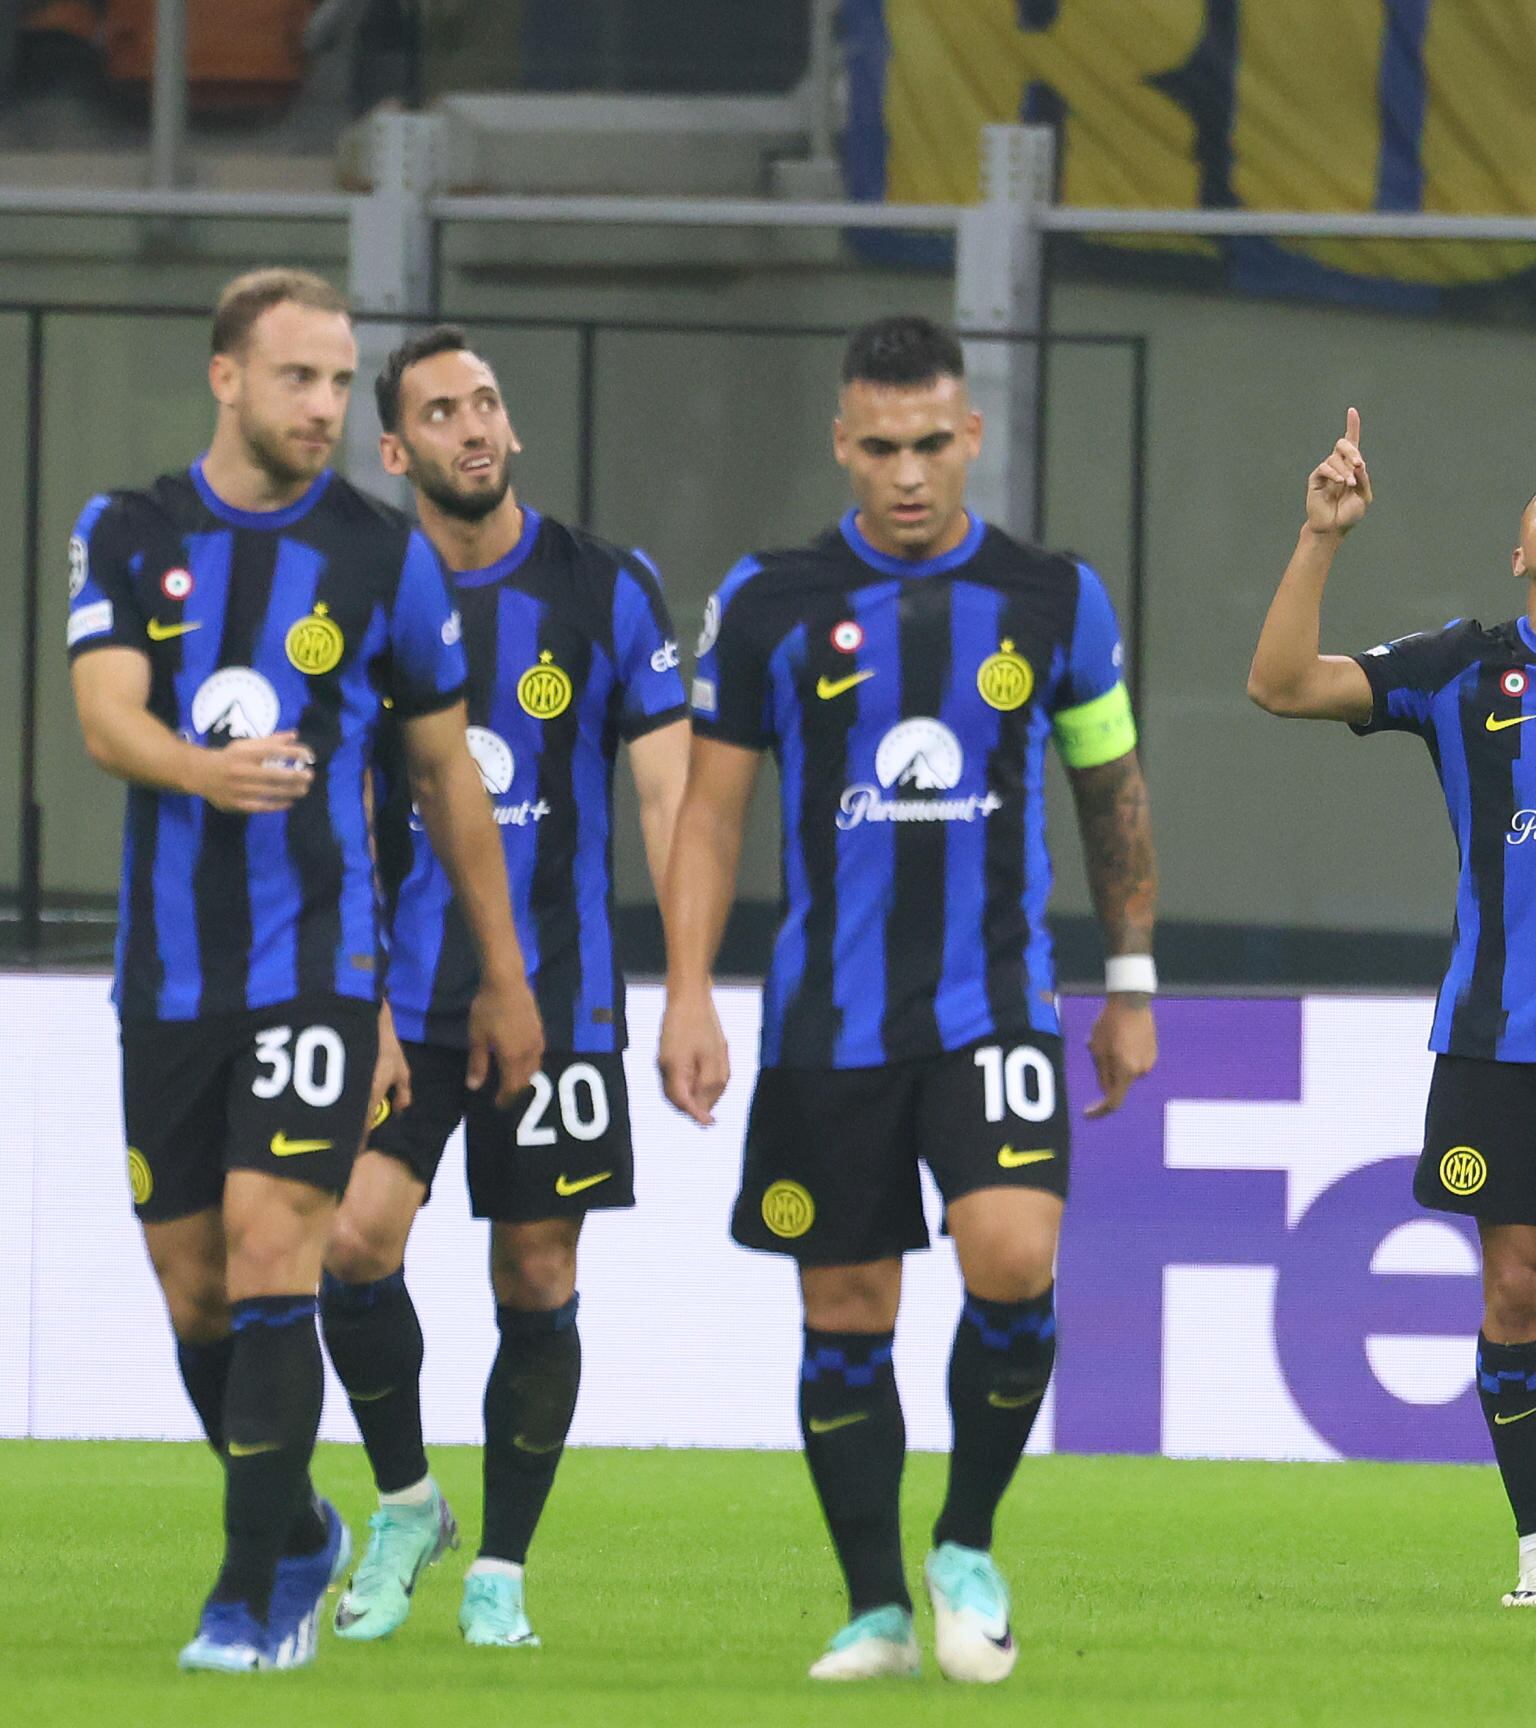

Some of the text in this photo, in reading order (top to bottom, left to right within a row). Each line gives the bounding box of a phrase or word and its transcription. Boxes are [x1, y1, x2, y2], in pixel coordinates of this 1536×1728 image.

[251, 1024, 347, 1107] 30
[515, 1062, 611, 1147] 20
[973, 1044, 1056, 1123] 10
